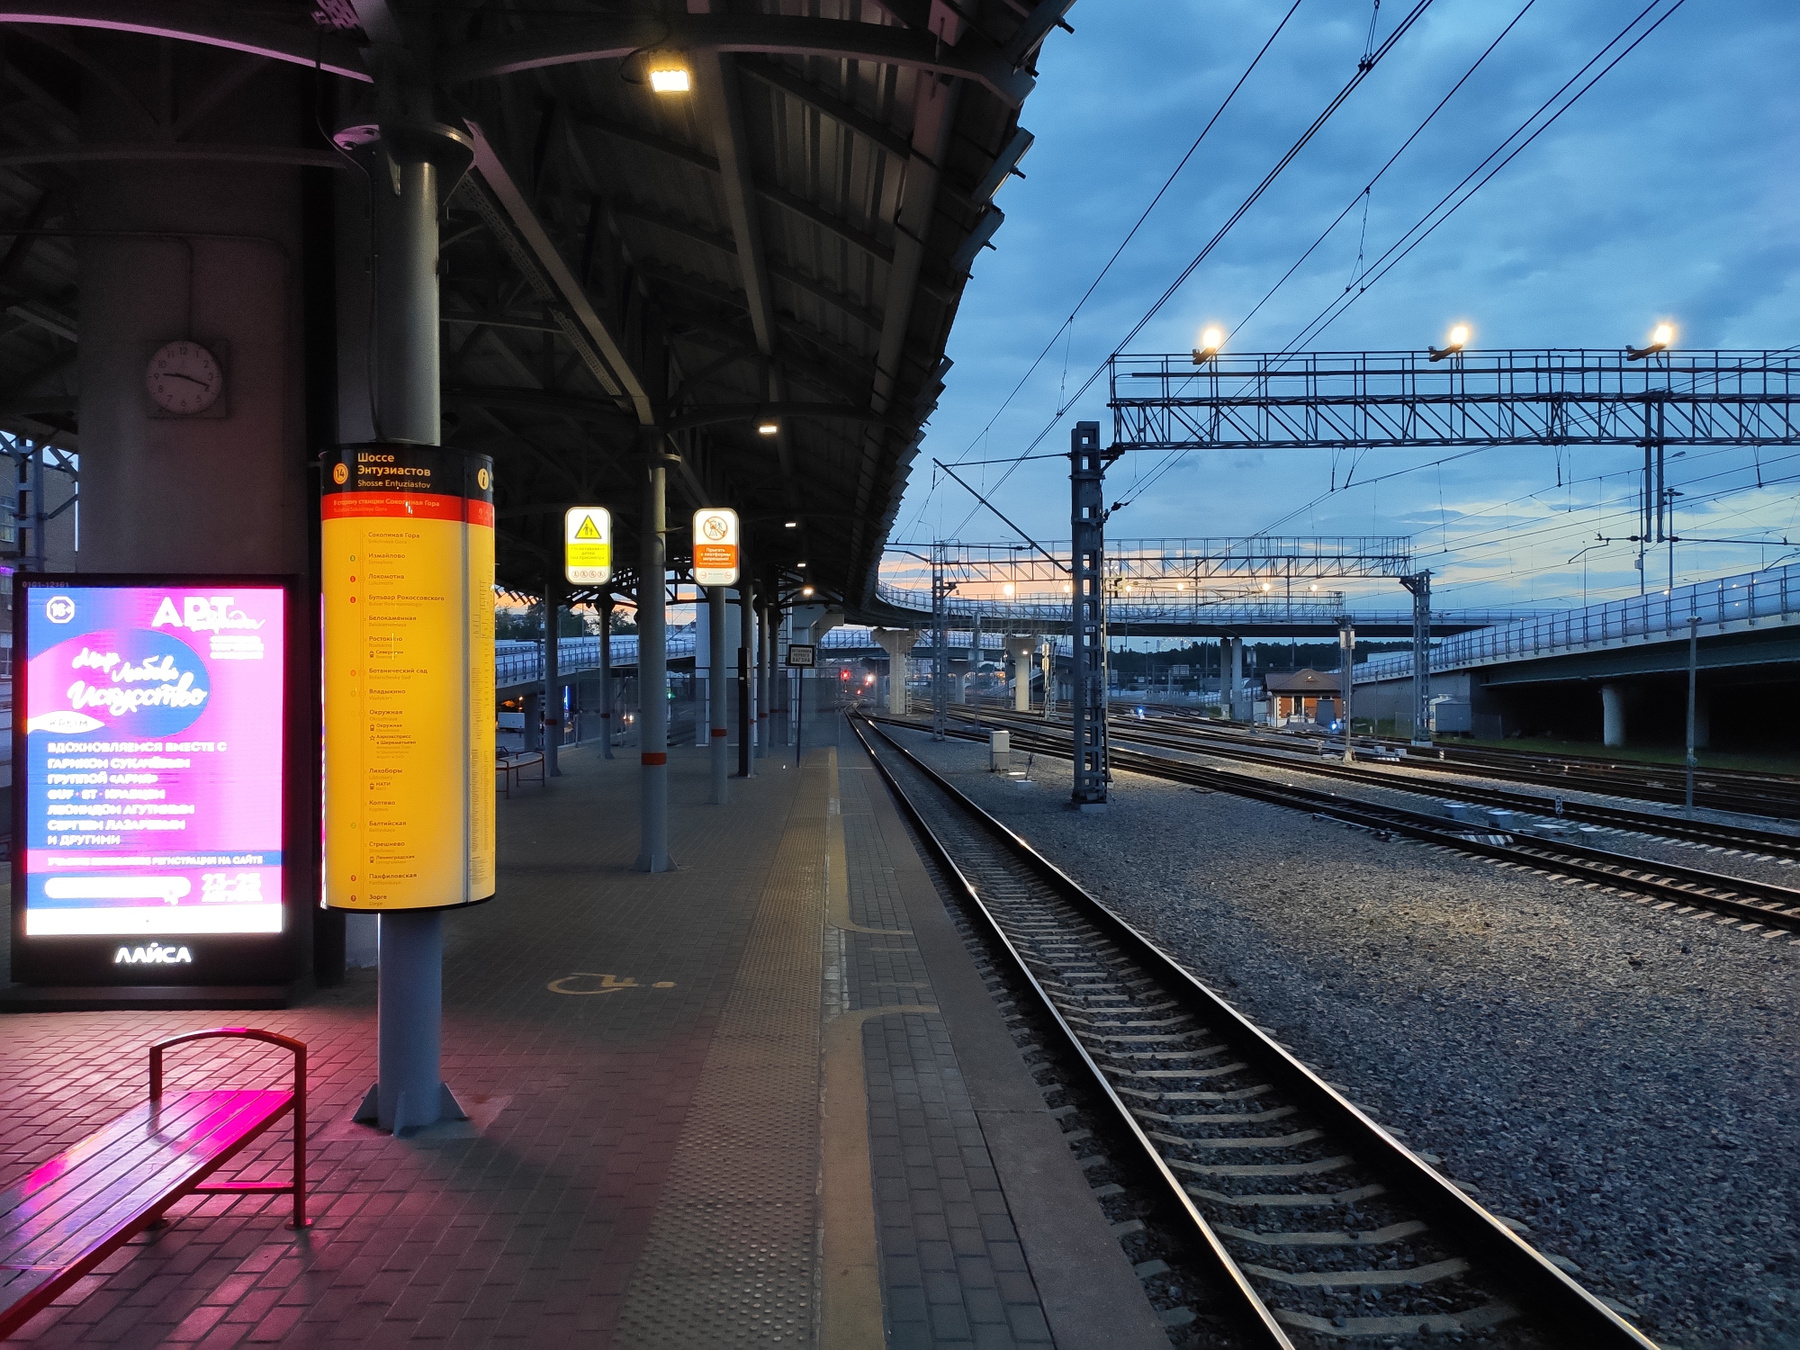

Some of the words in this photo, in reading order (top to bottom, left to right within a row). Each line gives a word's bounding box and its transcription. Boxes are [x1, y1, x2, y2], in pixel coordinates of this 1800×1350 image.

[179, 346, 188, 355] 12
[158, 360, 167, 368] 10
[203, 360, 209, 368] 2
[208, 373, 214, 381] 3
[358, 452, 395, 463] Шоссе
[336, 470, 345, 480] 14
[358, 465, 431, 477] Энтузиастов
[385, 480, 430, 489] Entuziastov
[47, 742, 163, 754] ВДОХНОВЛЯЕМСЯ
[165, 742, 215, 752] ВМЕСТЕ
[217, 742, 227, 752] С
[47, 758, 108, 768] ГАРИКОМ
[47, 771, 107, 784] ГРУППОЙ
[47, 804, 122, 816] ЛЕОНИДОМ
[47, 835, 57, 845] И
[60, 835, 120, 846] ДРУГИМИ
[152, 856, 216, 866] РЕГИСТРАЦИЯ
[218, 856, 232, 864] НА
[234, 854, 263, 864] САЙТЕ
[115, 943, 192, 963] ЛАЙСА
